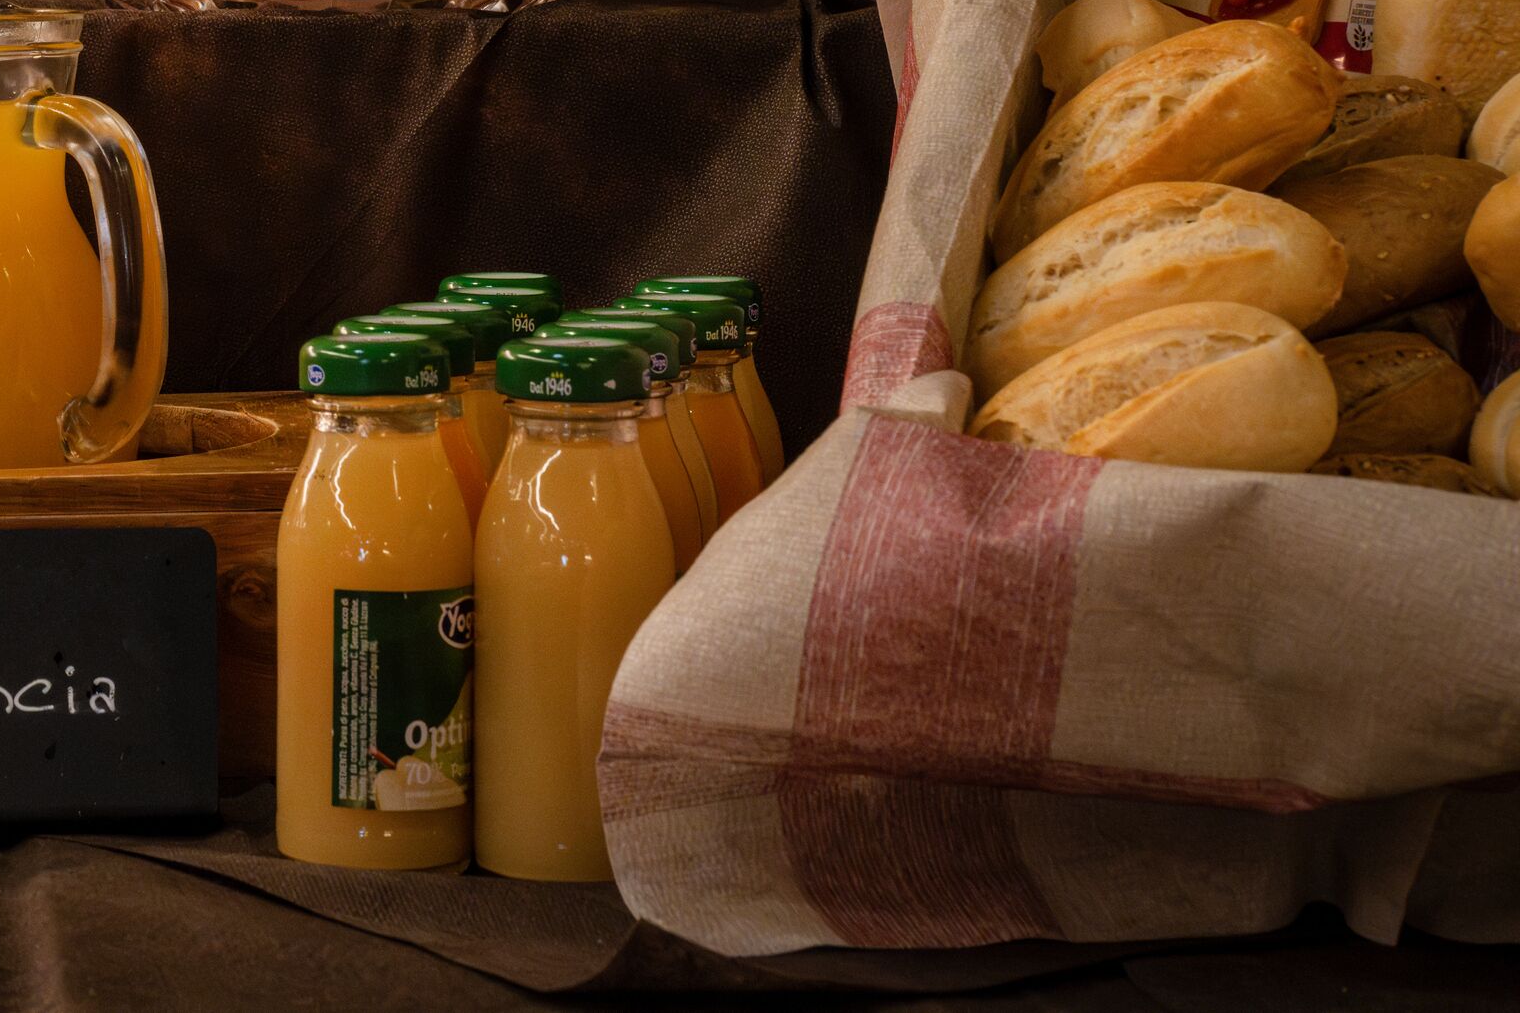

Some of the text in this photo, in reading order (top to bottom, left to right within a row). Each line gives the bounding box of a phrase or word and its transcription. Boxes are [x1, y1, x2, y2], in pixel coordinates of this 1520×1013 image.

[512, 318, 535, 333] 1946
[706, 325, 739, 341] Dal 1946
[529, 376, 572, 397] Dal 1946
[447, 605, 473, 639] Yog
[404, 714, 465, 761] Opti
